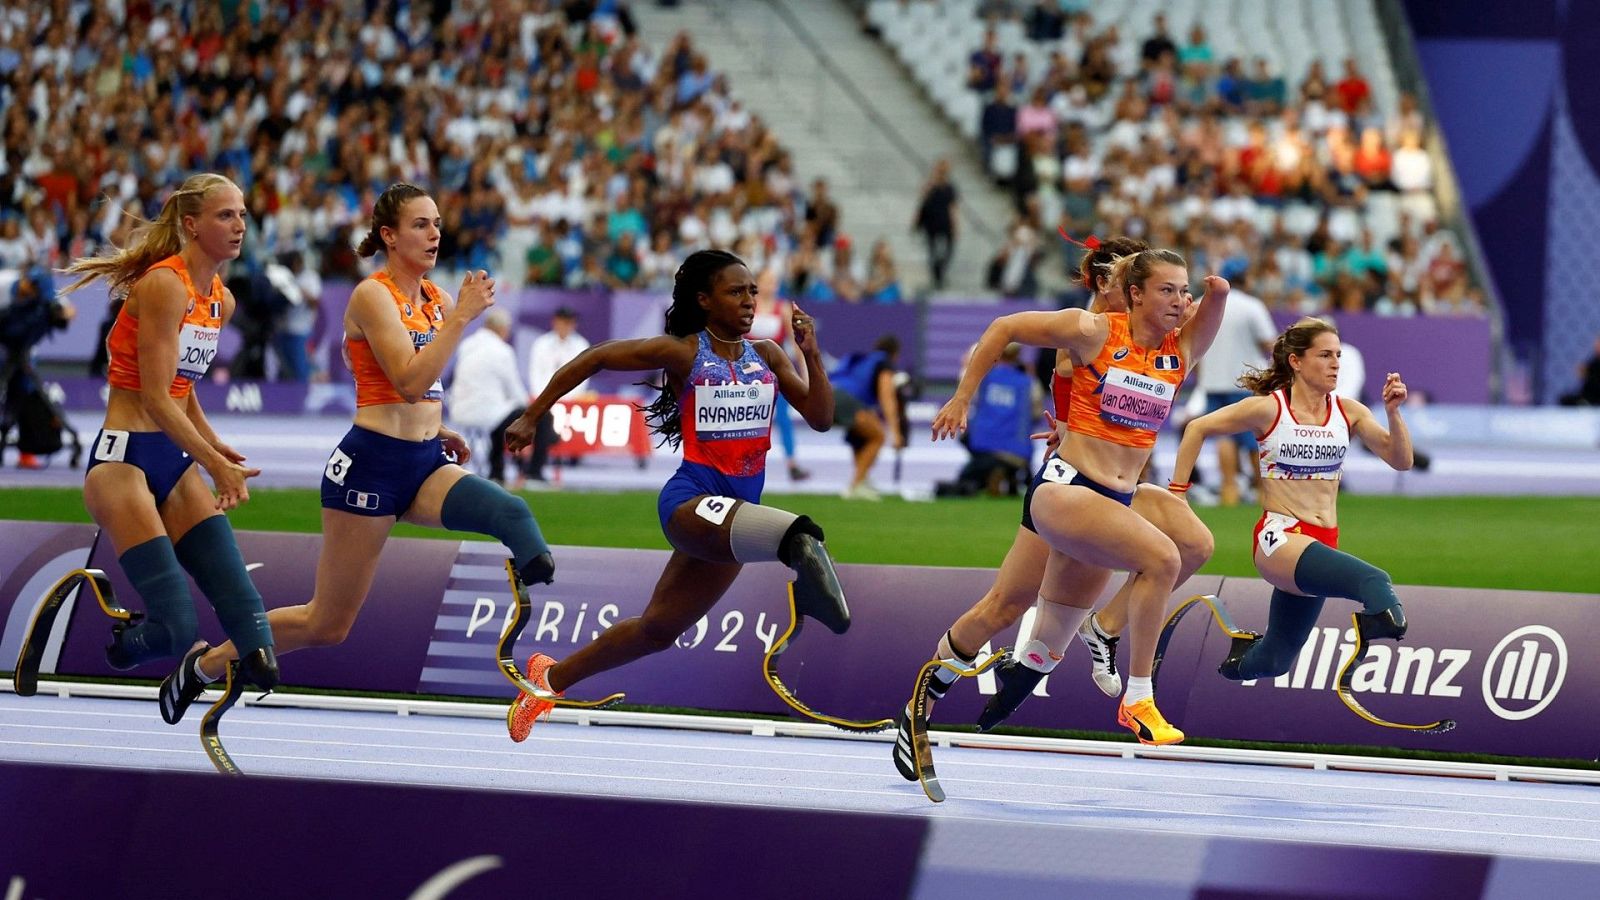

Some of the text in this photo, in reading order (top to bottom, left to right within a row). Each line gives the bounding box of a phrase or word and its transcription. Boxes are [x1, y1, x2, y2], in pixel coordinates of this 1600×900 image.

[1123, 375, 1153, 391] Allianz
[714, 389, 745, 399] Allianz
[1102, 392, 1118, 408] van
[699, 404, 771, 423] AYANBEKU
[1294, 428, 1334, 438] TOYOTA
[107, 434, 117, 455] 7
[1280, 443, 1347, 460] ANDRES BARRIO
[333, 459, 342, 476] 6
[706, 499, 724, 513] 5
[1264, 530, 1278, 547] 2
[1241, 626, 1472, 698] llianz
